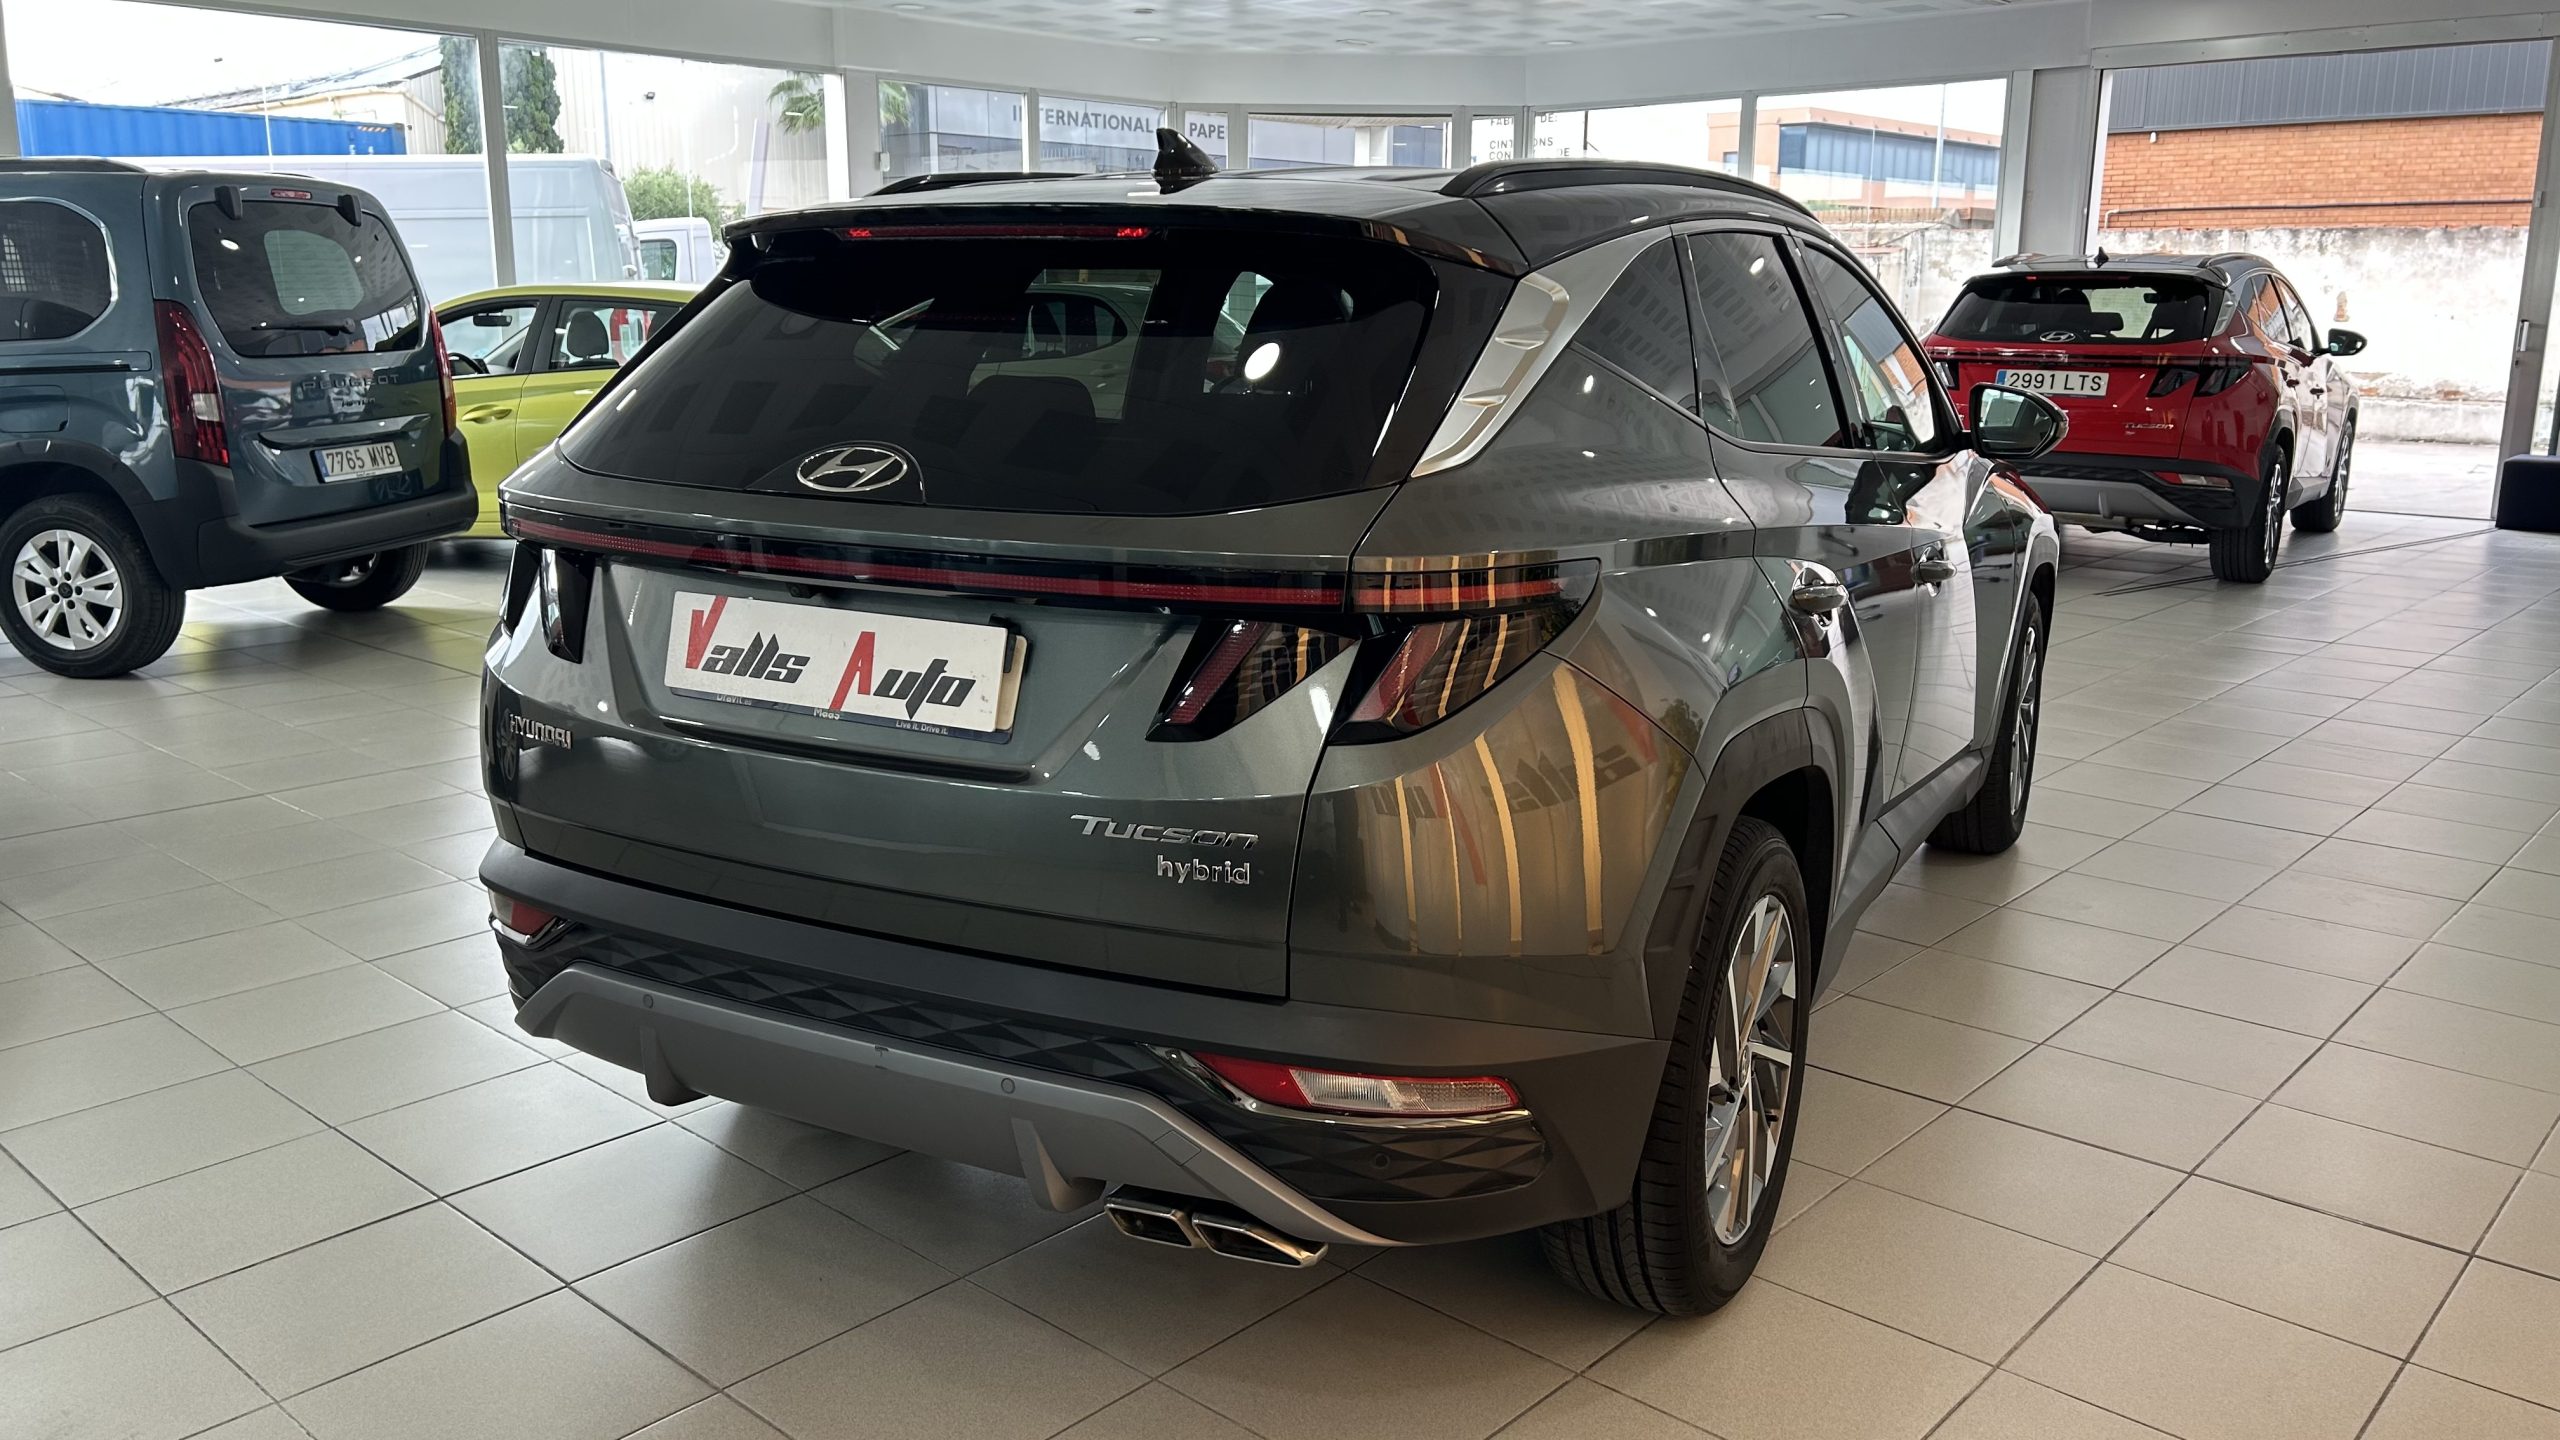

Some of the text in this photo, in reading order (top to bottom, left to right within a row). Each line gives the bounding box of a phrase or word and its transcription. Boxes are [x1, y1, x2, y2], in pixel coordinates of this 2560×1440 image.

[2009, 372, 2102, 392] 2991 LTS
[326, 444, 396, 474] 7765 MVB
[685, 595, 977, 721] Valls Auto
[509, 713, 572, 750] HYUNDAI
[1157, 854, 1251, 885] hybrid
